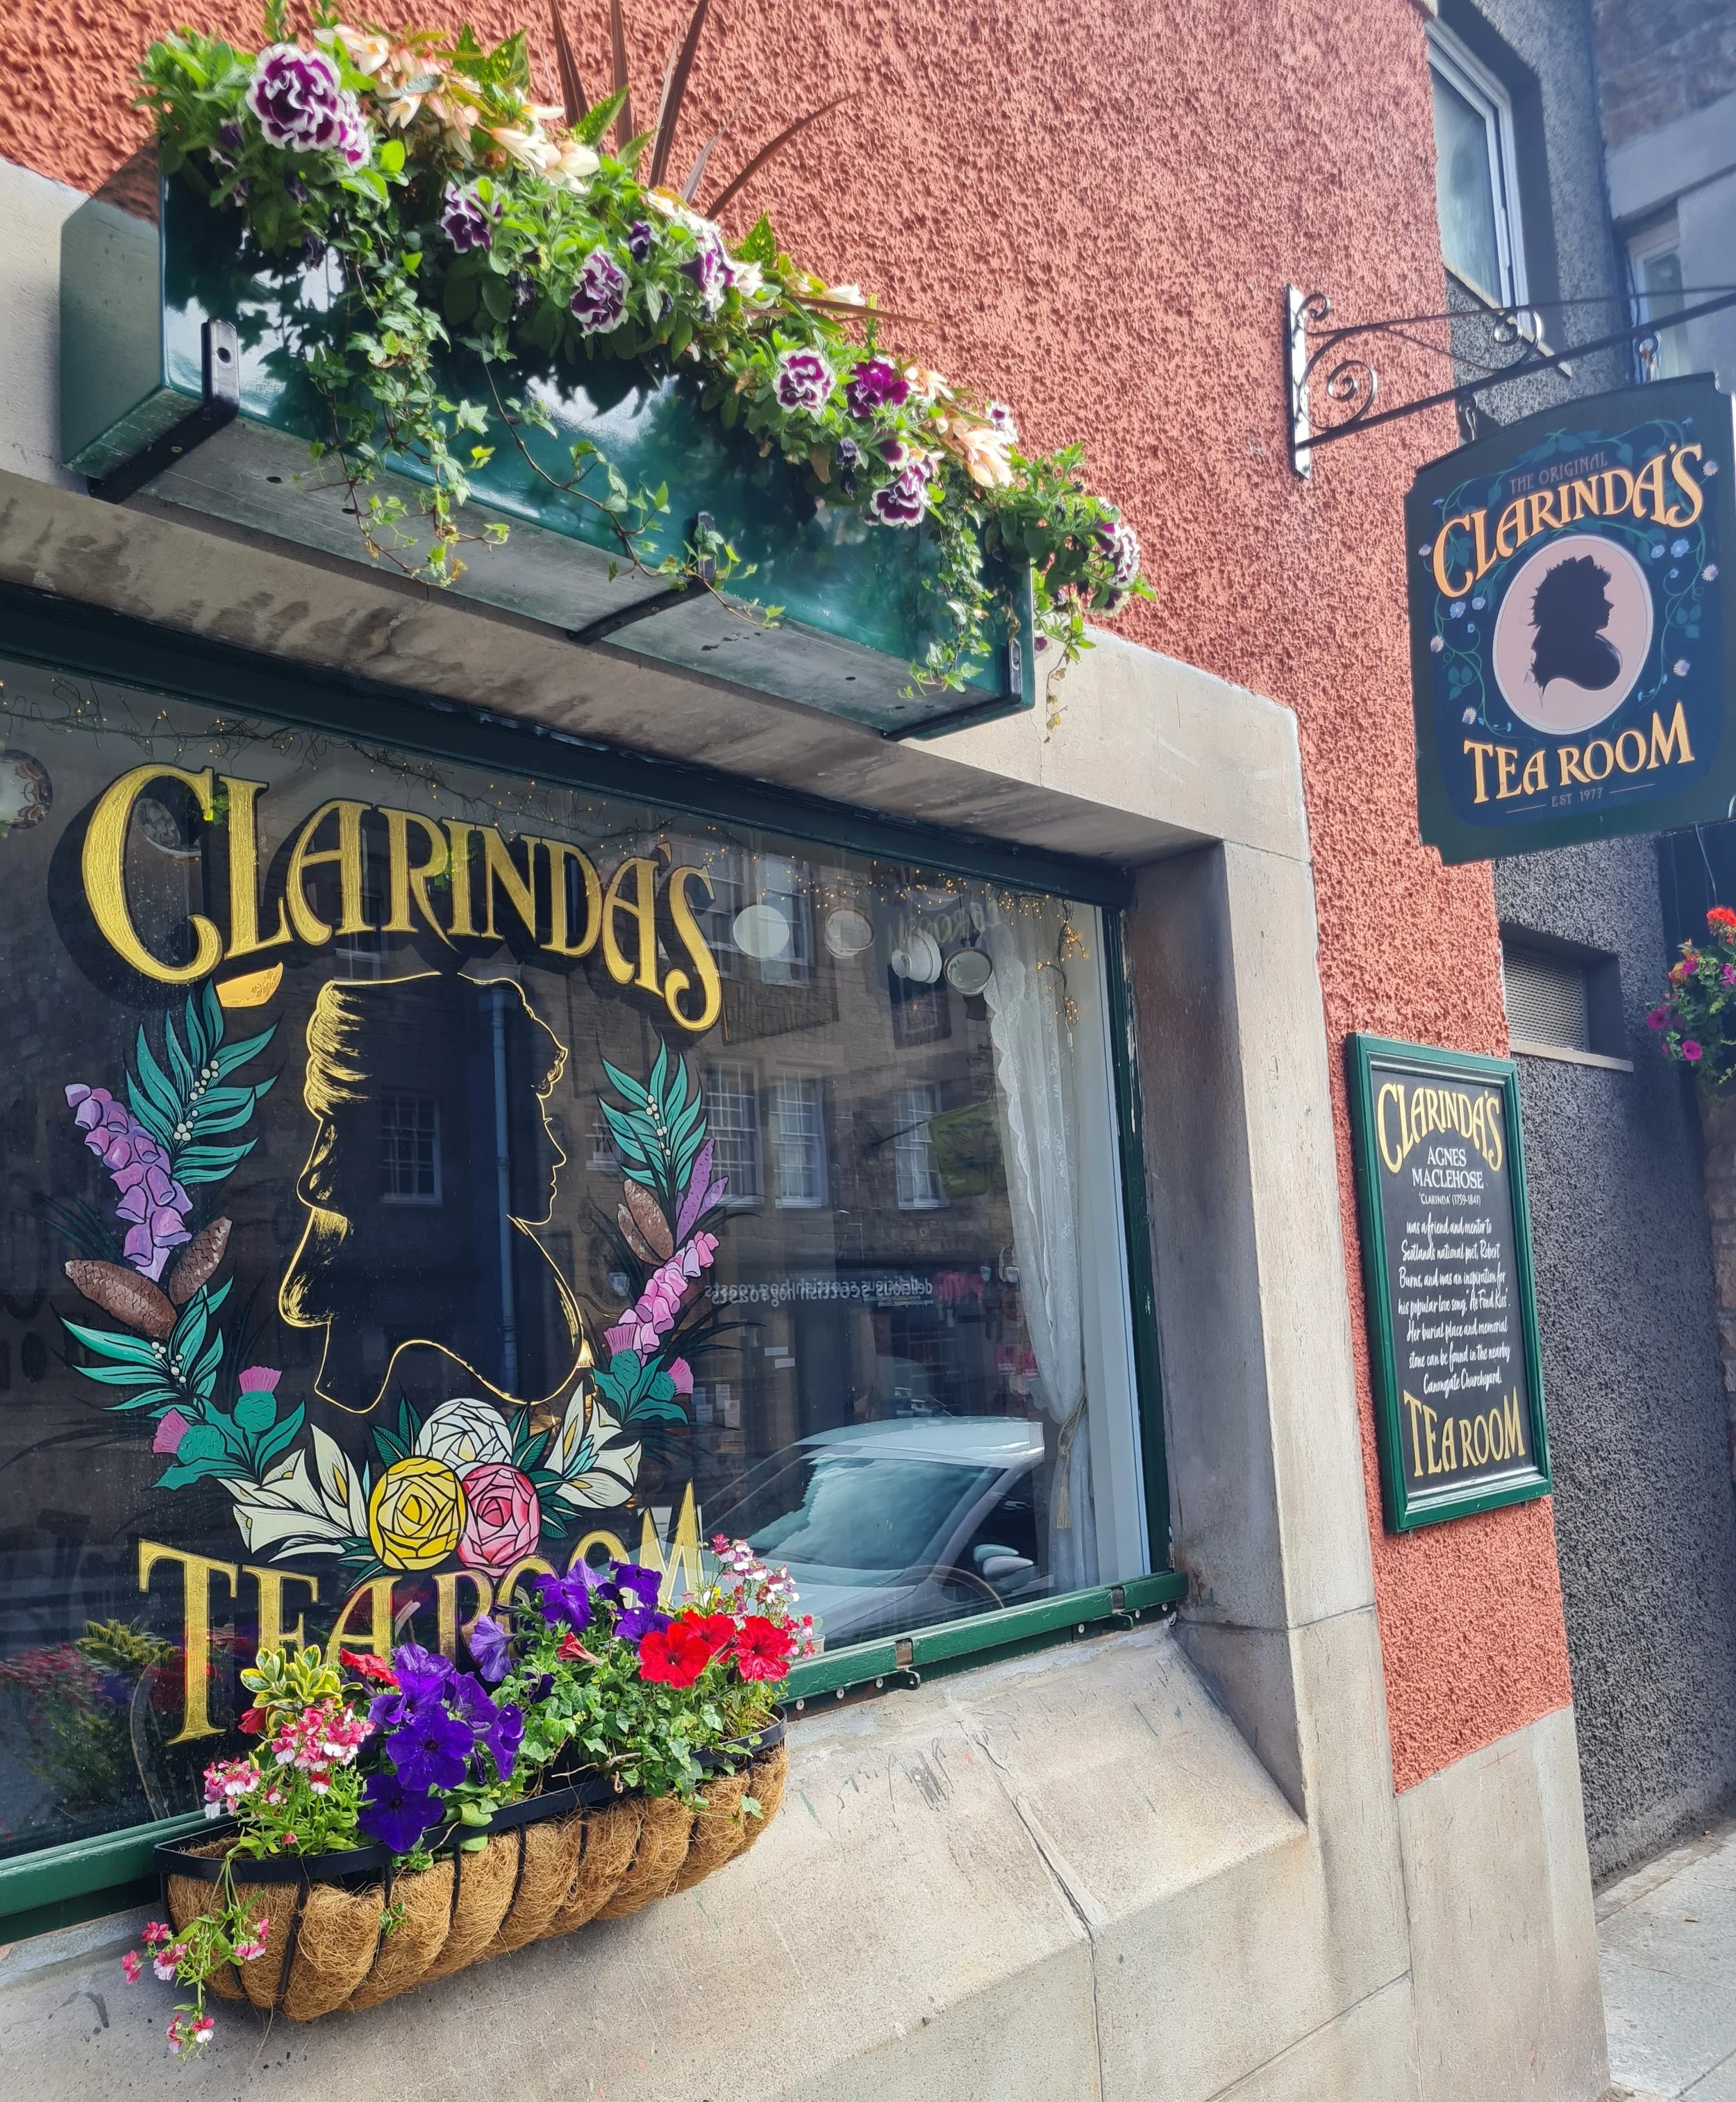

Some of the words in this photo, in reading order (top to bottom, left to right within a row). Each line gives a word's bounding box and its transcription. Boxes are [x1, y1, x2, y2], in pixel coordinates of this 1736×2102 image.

[1509, 476, 1534, 495] THE
[1539, 451, 1608, 486] ORIGINAL
[1432, 442, 1703, 599] CLARINDA'S
[1462, 739, 1549, 804] TEA
[1556, 700, 1696, 786] ROOM
[1551, 792, 1573, 808] EST
[1579, 787, 1604, 803] 1977
[81, 761, 724, 1031] CLARINDA'S
[1377, 1082, 1503, 1174] CLARINDA'S
[1426, 1145, 1467, 1167] AGNES
[1411, 1167, 1485, 1190] MACLEHOSE
[1406, 1221, 1420, 1235] was
[1427, 1211, 1449, 1243] friend
[1450, 1216, 1464, 1235] and
[1464, 1217, 1485, 1235] mentor
[1485, 1217, 1492, 1235] to
[1437, 1242, 1465, 1260] national
[1479, 1239, 1501, 1260] Robert
[1399, 1266, 1423, 1289] Burns,
[1424, 1267, 1439, 1287] and
[1439, 1273, 1452, 1285] was
[1453, 1274, 1462, 1285] an
[1463, 1267, 1496, 1288] inspiration
[1496, 1261, 1506, 1291] for
[1398, 1297, 1409, 1315] his
[1410, 1295, 1437, 1320] popular
[1439, 1294, 1451, 1312] love
[1451, 1298, 1467, 1317] song,
[1478, 1289, 1494, 1310] Fond
[1406, 1319, 1421, 1344] Her
[1421, 1321, 1445, 1342] burial
[1445, 1320, 1464, 1344] place
[1463, 1317, 1479, 1336] and
[1478, 1315, 1508, 1335] memorial
[1409, 1351, 1425, 1369] stone
[1426, 1353, 1439, 1367] can
[1440, 1347, 1449, 1367] be
[1449, 1340, 1469, 1373] found
[1469, 1348, 1476, 1362] in
[1476, 1343, 1488, 1362] the
[1488, 1341, 1511, 1364] nearby
[1424, 1372, 1460, 1400] Canongate
[1403, 1389, 1458, 1478] TEA
[1458, 1385, 1526, 1468] ROOM
[139, 1538, 403, 1746] TEA
